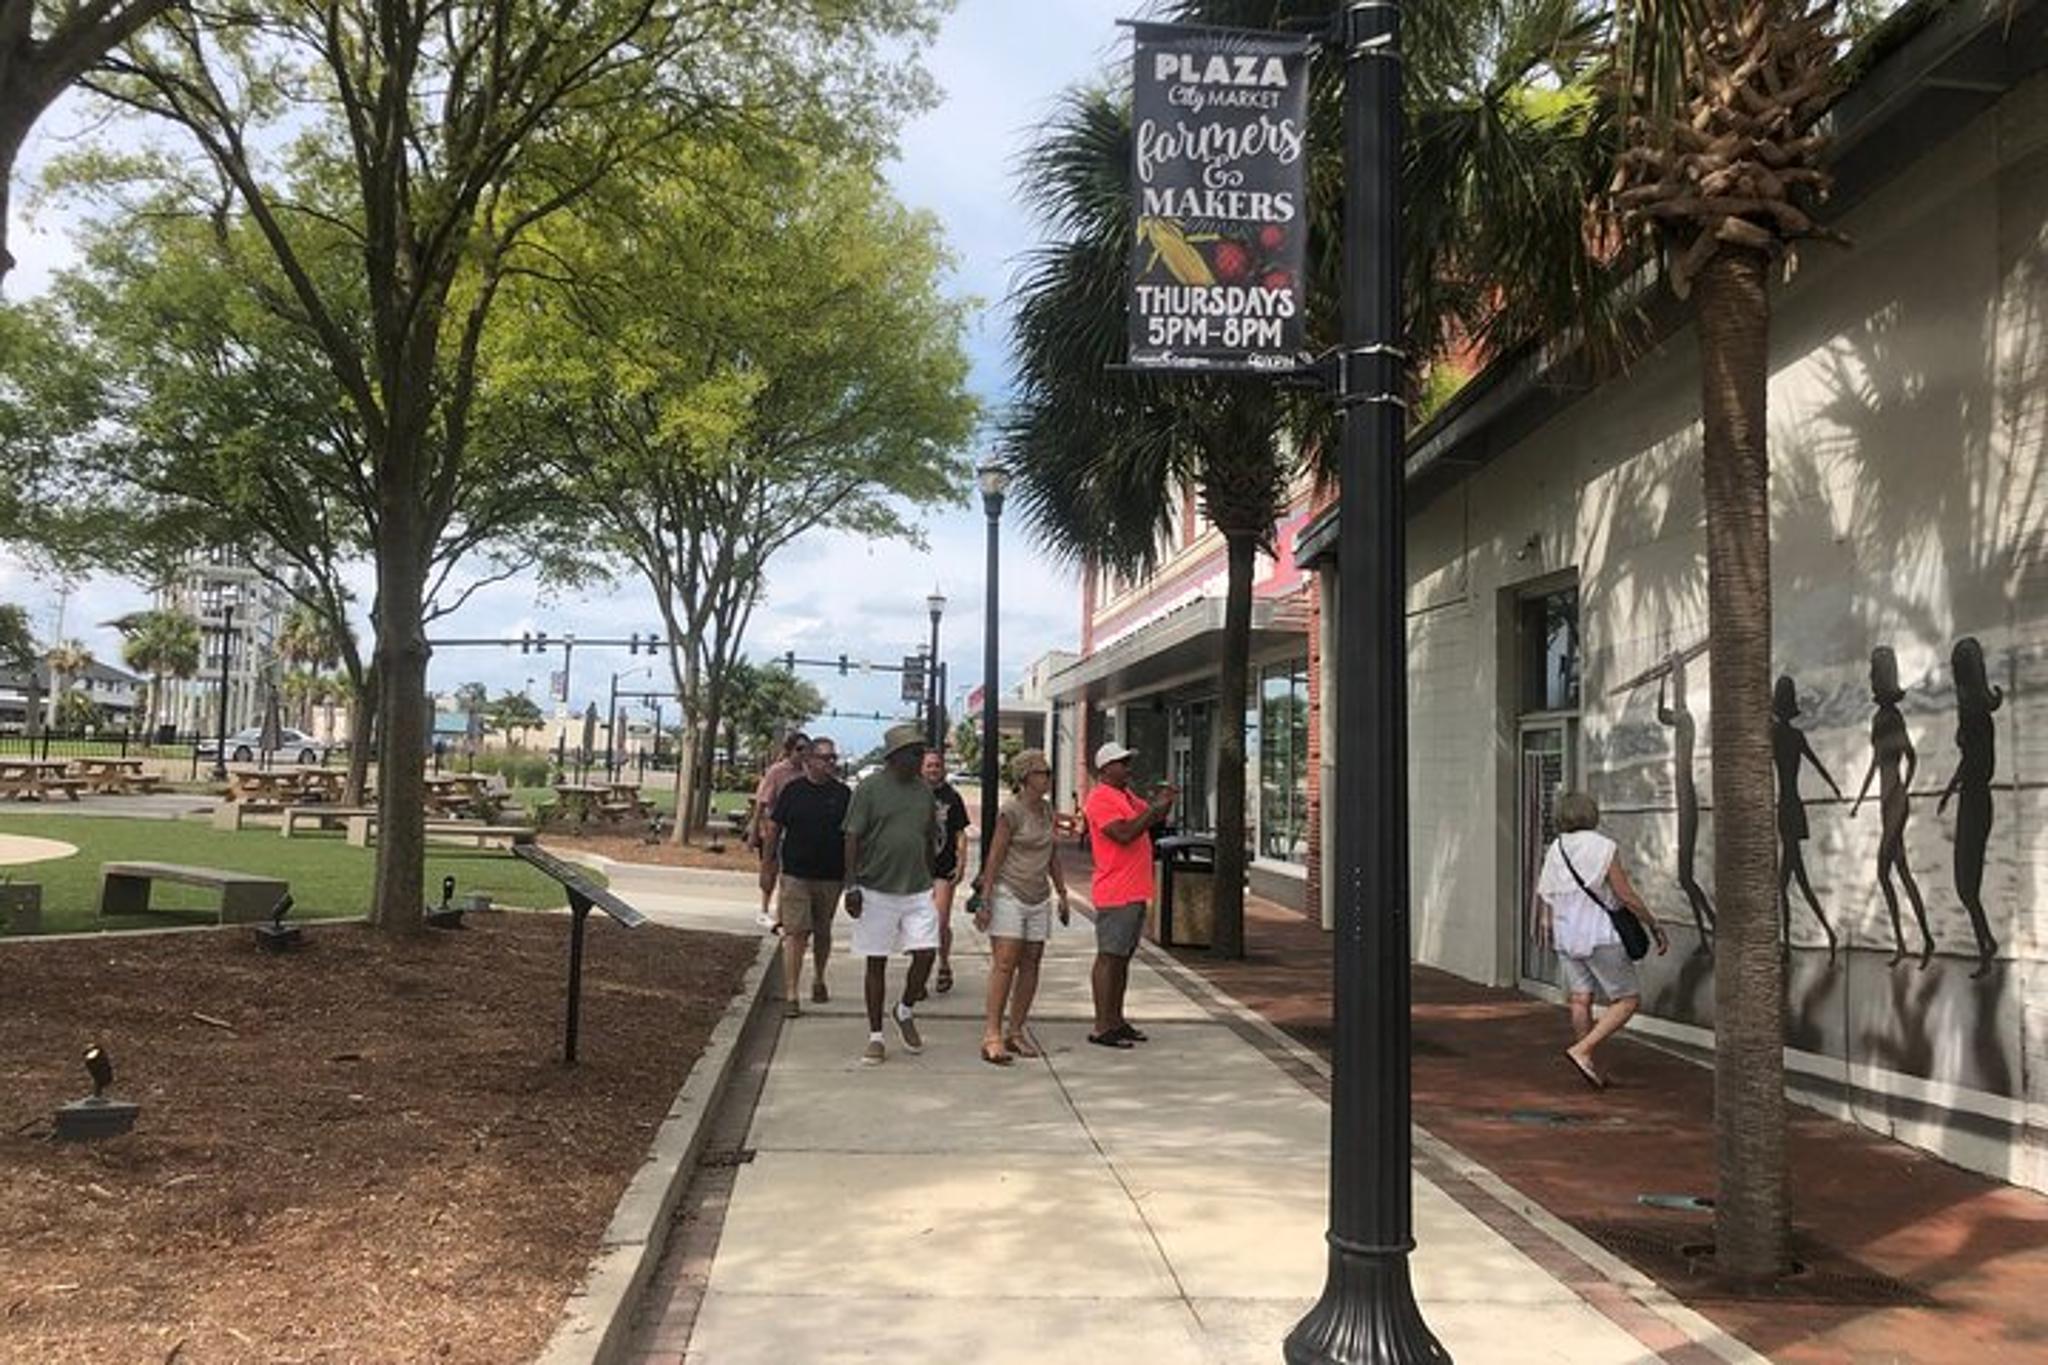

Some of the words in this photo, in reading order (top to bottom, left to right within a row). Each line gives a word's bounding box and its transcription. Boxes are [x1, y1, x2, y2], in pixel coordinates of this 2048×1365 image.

[1155, 53, 1287, 87] PLAZA
[1207, 91, 1281, 110] MARKET
[1136, 115, 1304, 183] farmers
[1202, 157, 1244, 188] &
[1142, 187, 1296, 223] MAKERS
[1135, 285, 1296, 318] THURSDAYS
[1148, 317, 1283, 349] 5PM-8PM
